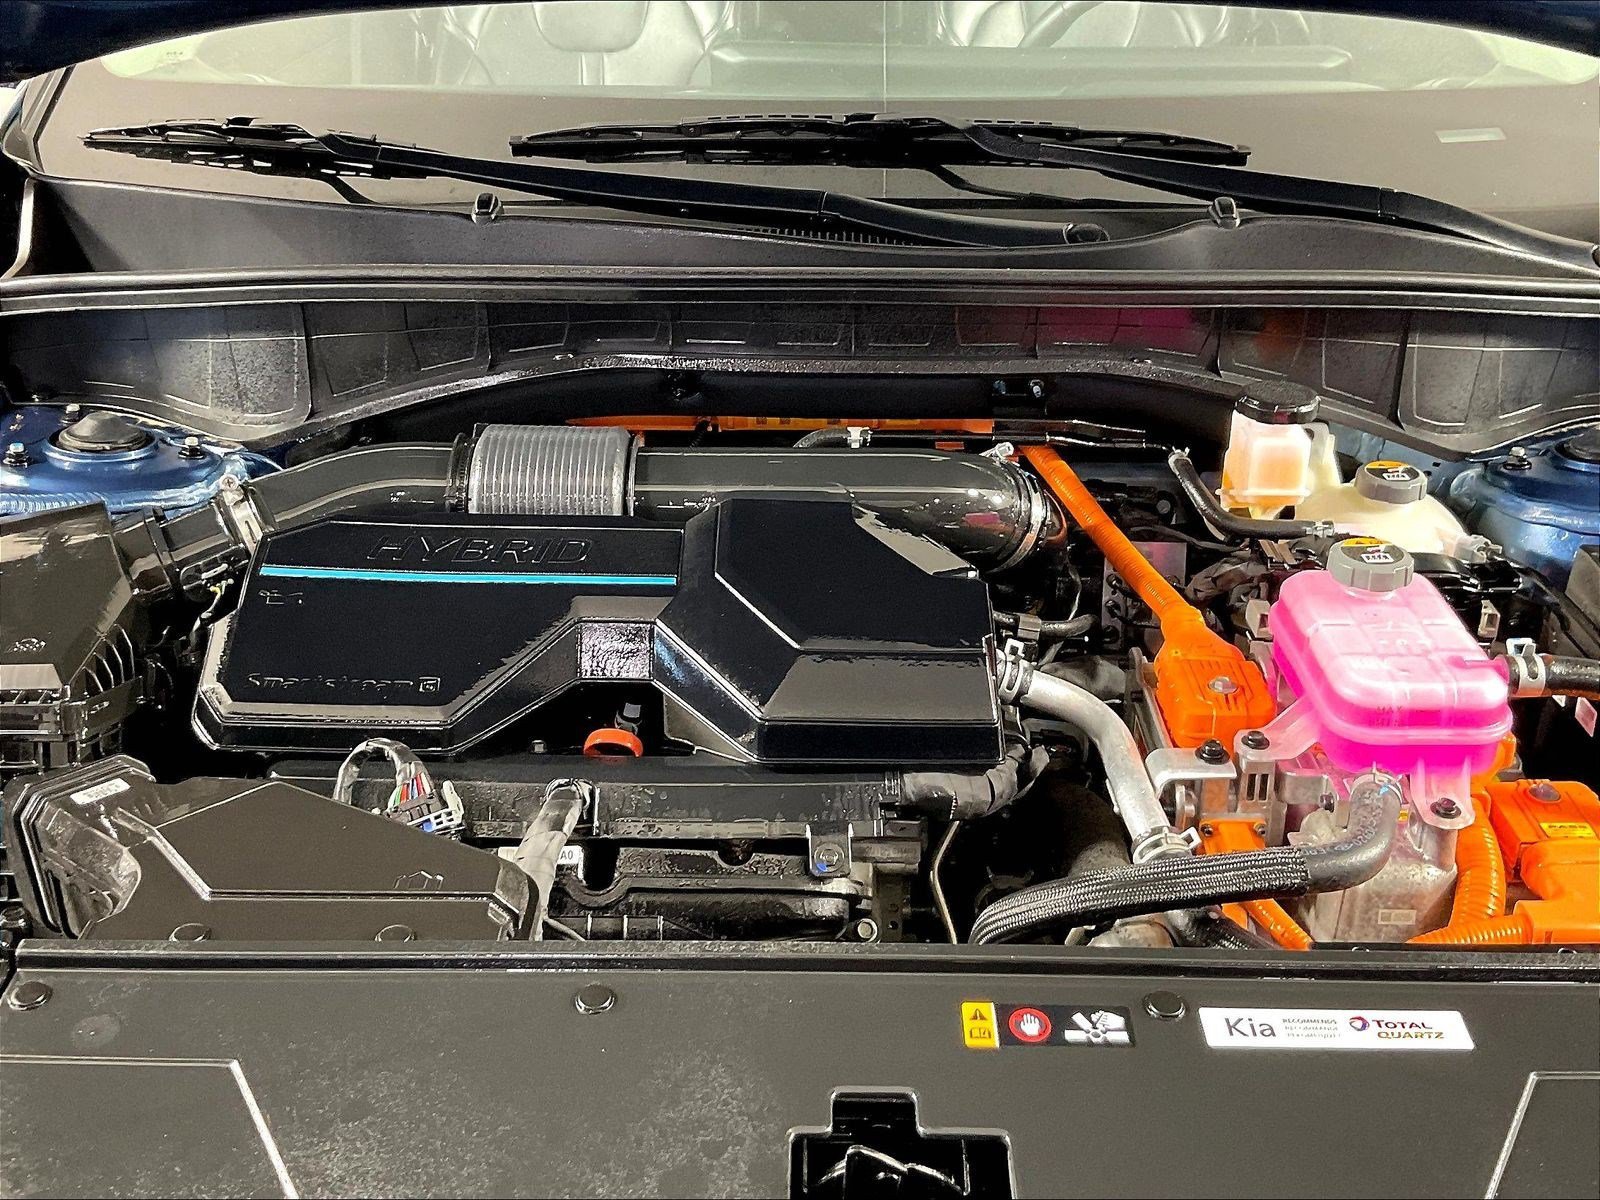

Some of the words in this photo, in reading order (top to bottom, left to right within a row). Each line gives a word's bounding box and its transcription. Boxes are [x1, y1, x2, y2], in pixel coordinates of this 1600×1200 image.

[366, 536, 592, 563] HYBRID
[1224, 1017, 1276, 1037] Kia
[1371, 1019, 1433, 1030] TOTAL
[1377, 1031, 1445, 1040] QUARTZ
